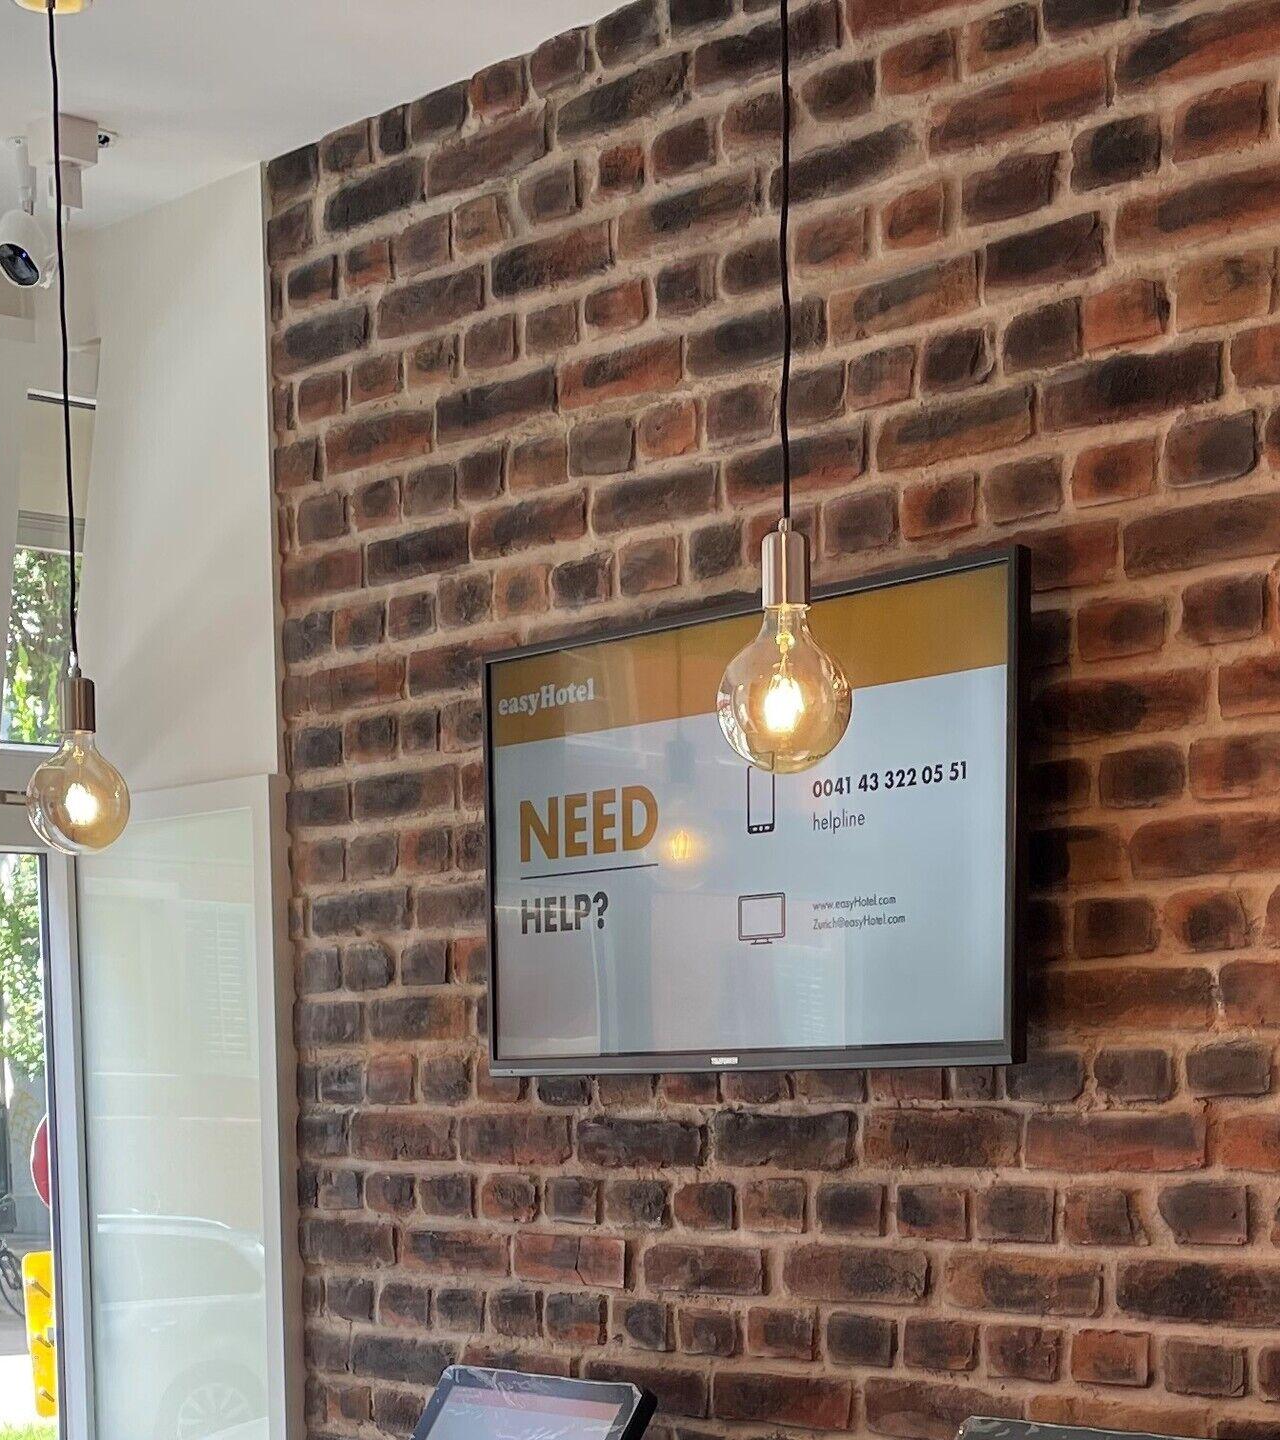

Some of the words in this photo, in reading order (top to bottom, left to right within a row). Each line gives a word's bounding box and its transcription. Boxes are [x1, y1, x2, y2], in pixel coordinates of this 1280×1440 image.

[497, 677, 595, 716] easyHotel
[812, 776, 852, 798] 0041
[858, 772, 880, 792] 43
[884, 767, 917, 790] 322
[921, 764, 944, 785] 05
[949, 760, 968, 782] 51
[519, 784, 659, 863] NEED
[812, 808, 867, 835] helpline
[521, 890, 610, 935] HELP?
